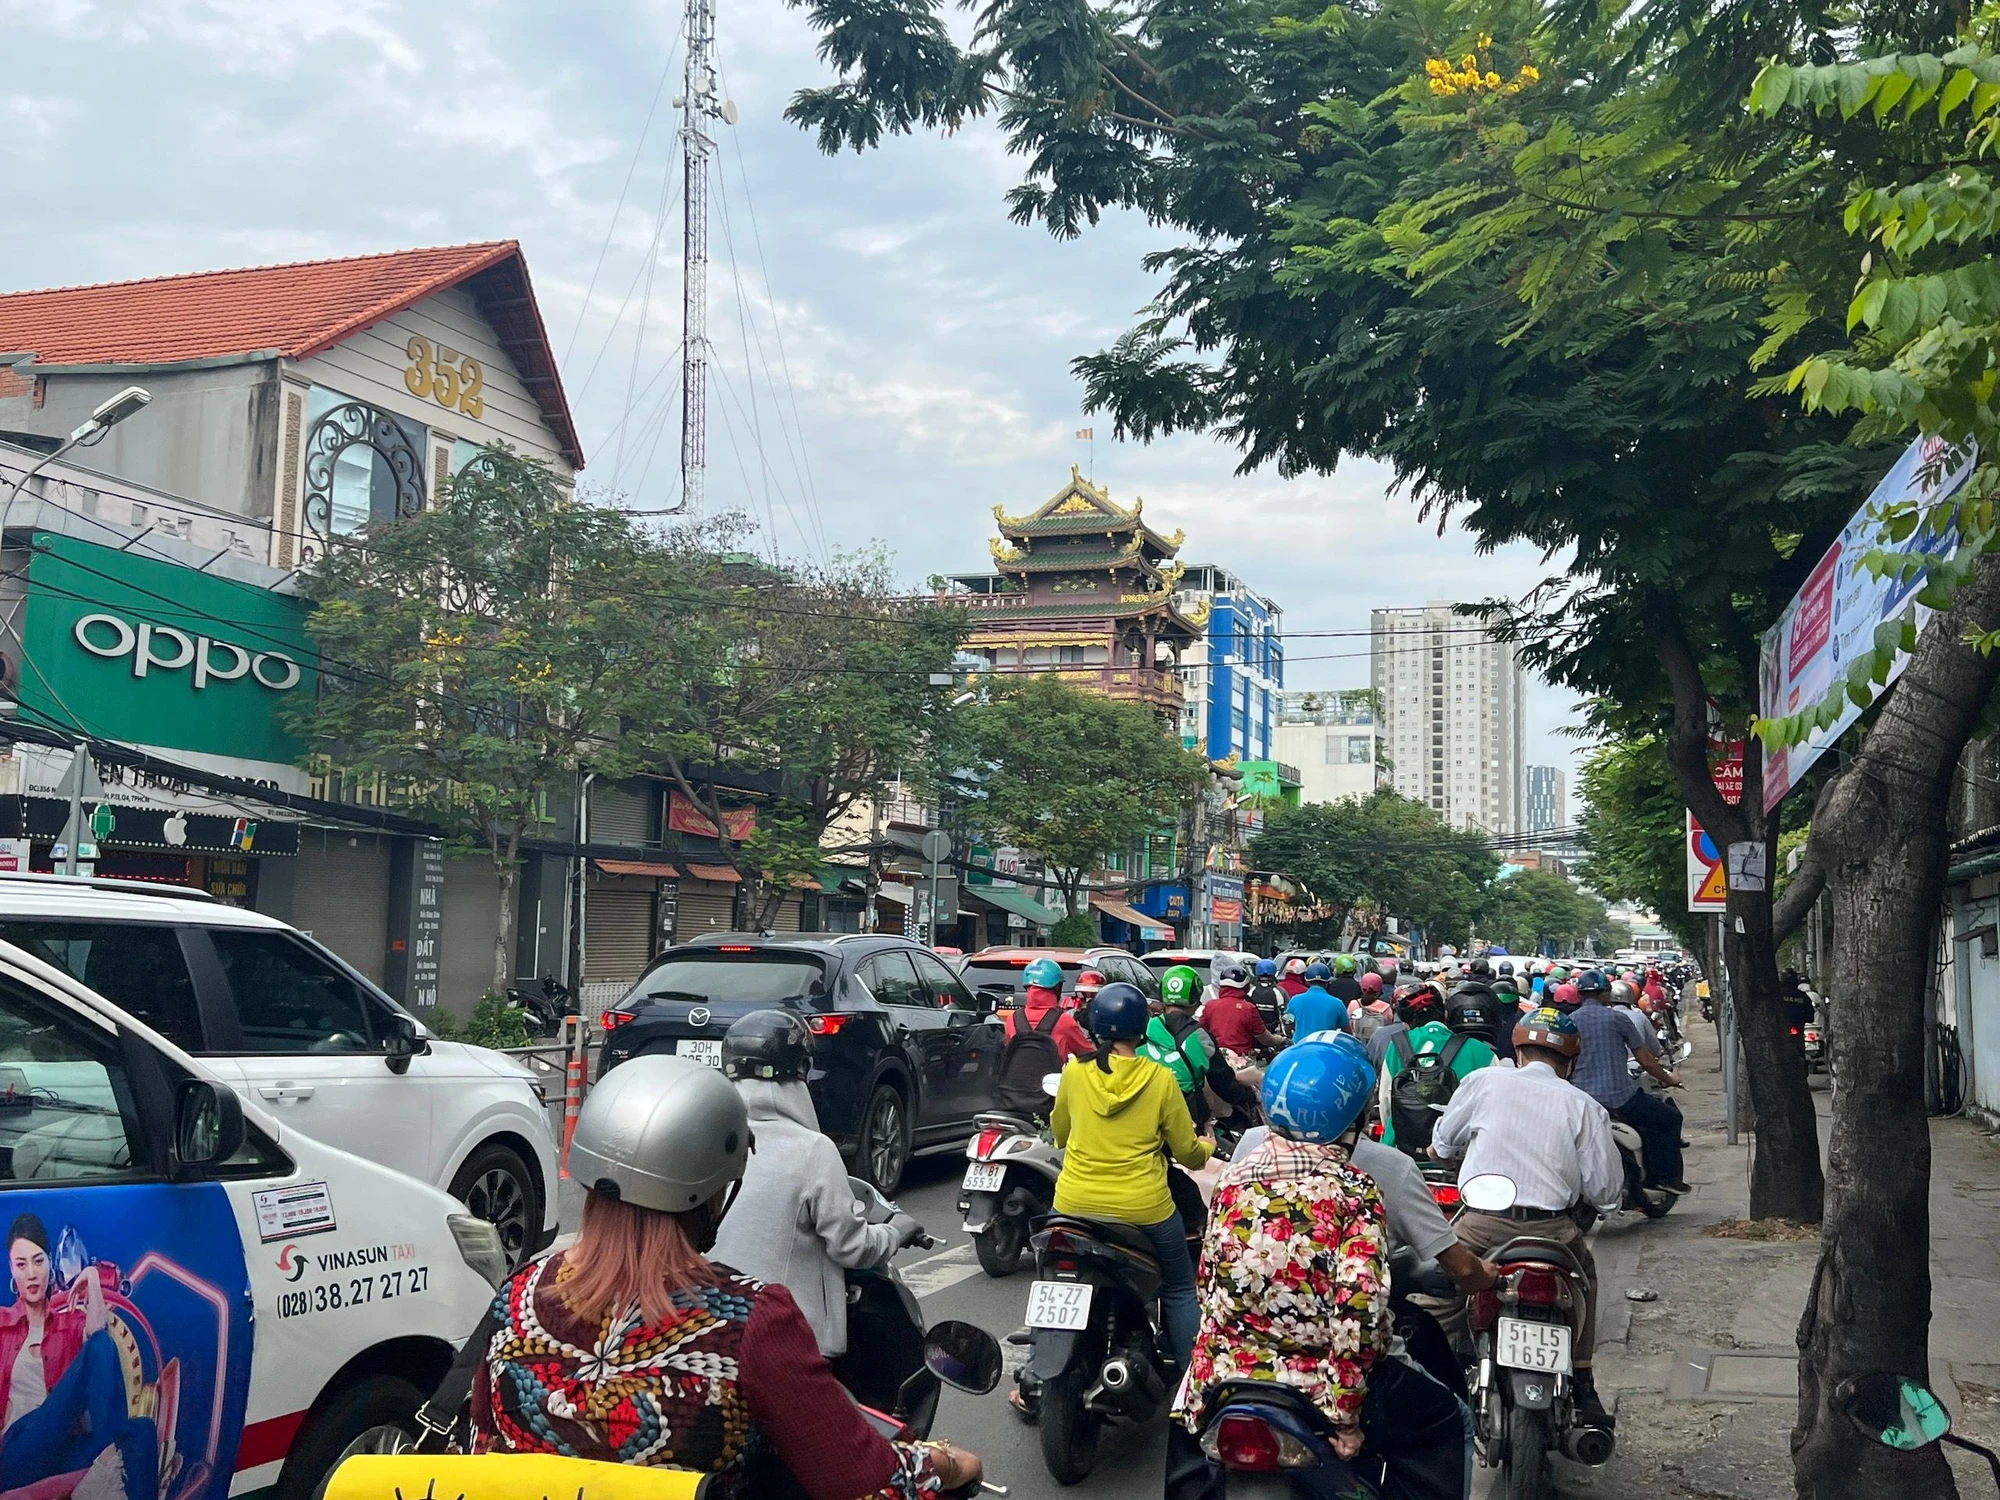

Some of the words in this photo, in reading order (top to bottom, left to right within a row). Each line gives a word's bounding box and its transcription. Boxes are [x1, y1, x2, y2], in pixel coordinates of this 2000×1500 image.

[405, 336, 483, 419] 352
[420, 884, 436, 906] NHÀ
[415, 930, 435, 957] ĐẤT
[690, 1041, 713, 1054] 30H
[317, 1246, 388, 1272] VINASUN
[391, 1243, 416, 1262] TAXI
[380, 1271, 403, 1300] 27
[408, 1265, 429, 1294] 27
[1039, 1285, 1083, 1306] 54-Z7
[1034, 1305, 1080, 1326] 2507
[1509, 1322, 1560, 1348] 51-L5
[1508, 1343, 1560, 1369] 1657
